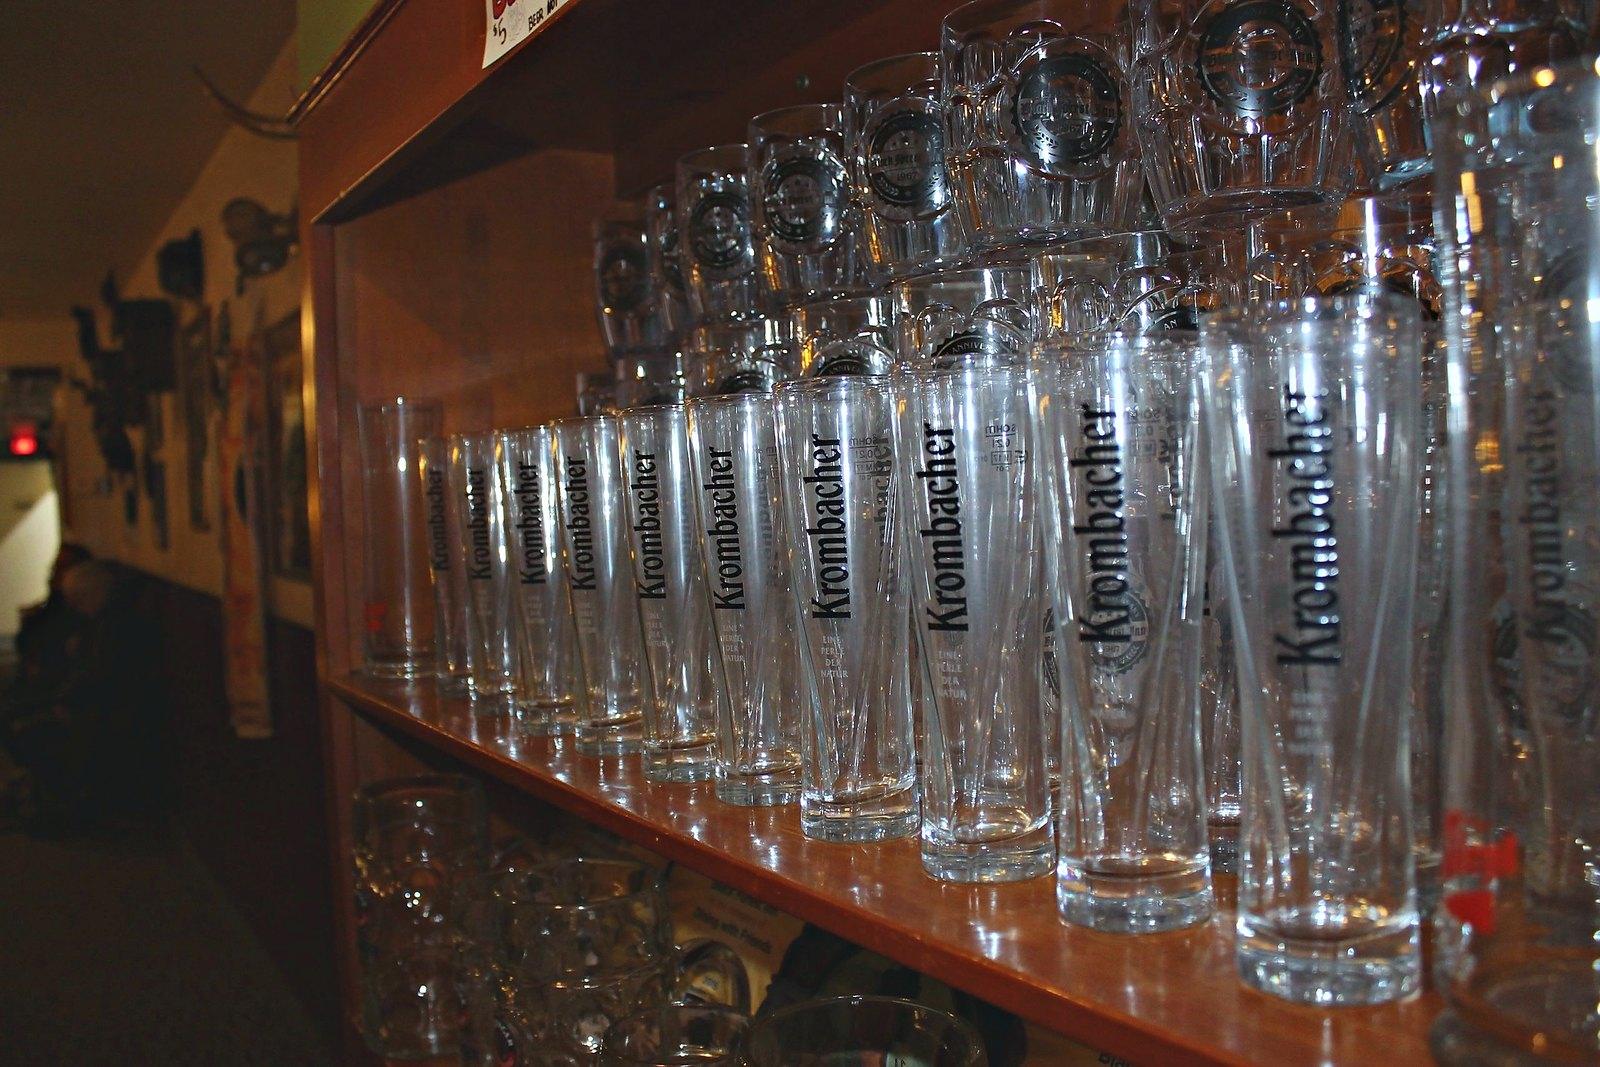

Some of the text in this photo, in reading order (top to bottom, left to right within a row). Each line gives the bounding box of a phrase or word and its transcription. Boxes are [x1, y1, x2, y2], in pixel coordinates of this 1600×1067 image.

[528, 8, 544, 31] BEER
[514, 461, 547, 586] Krombacher
[565, 455, 597, 591] Krombacher
[631, 449, 667, 600] Krombacher
[703, 446, 746, 611] Krombacher
[803, 433, 852, 620] Krombacher
[916, 422, 970, 632] Krombacher
[1070, 402, 1133, 643] Krombacher
[1268, 382, 1342, 667] Krombacher
